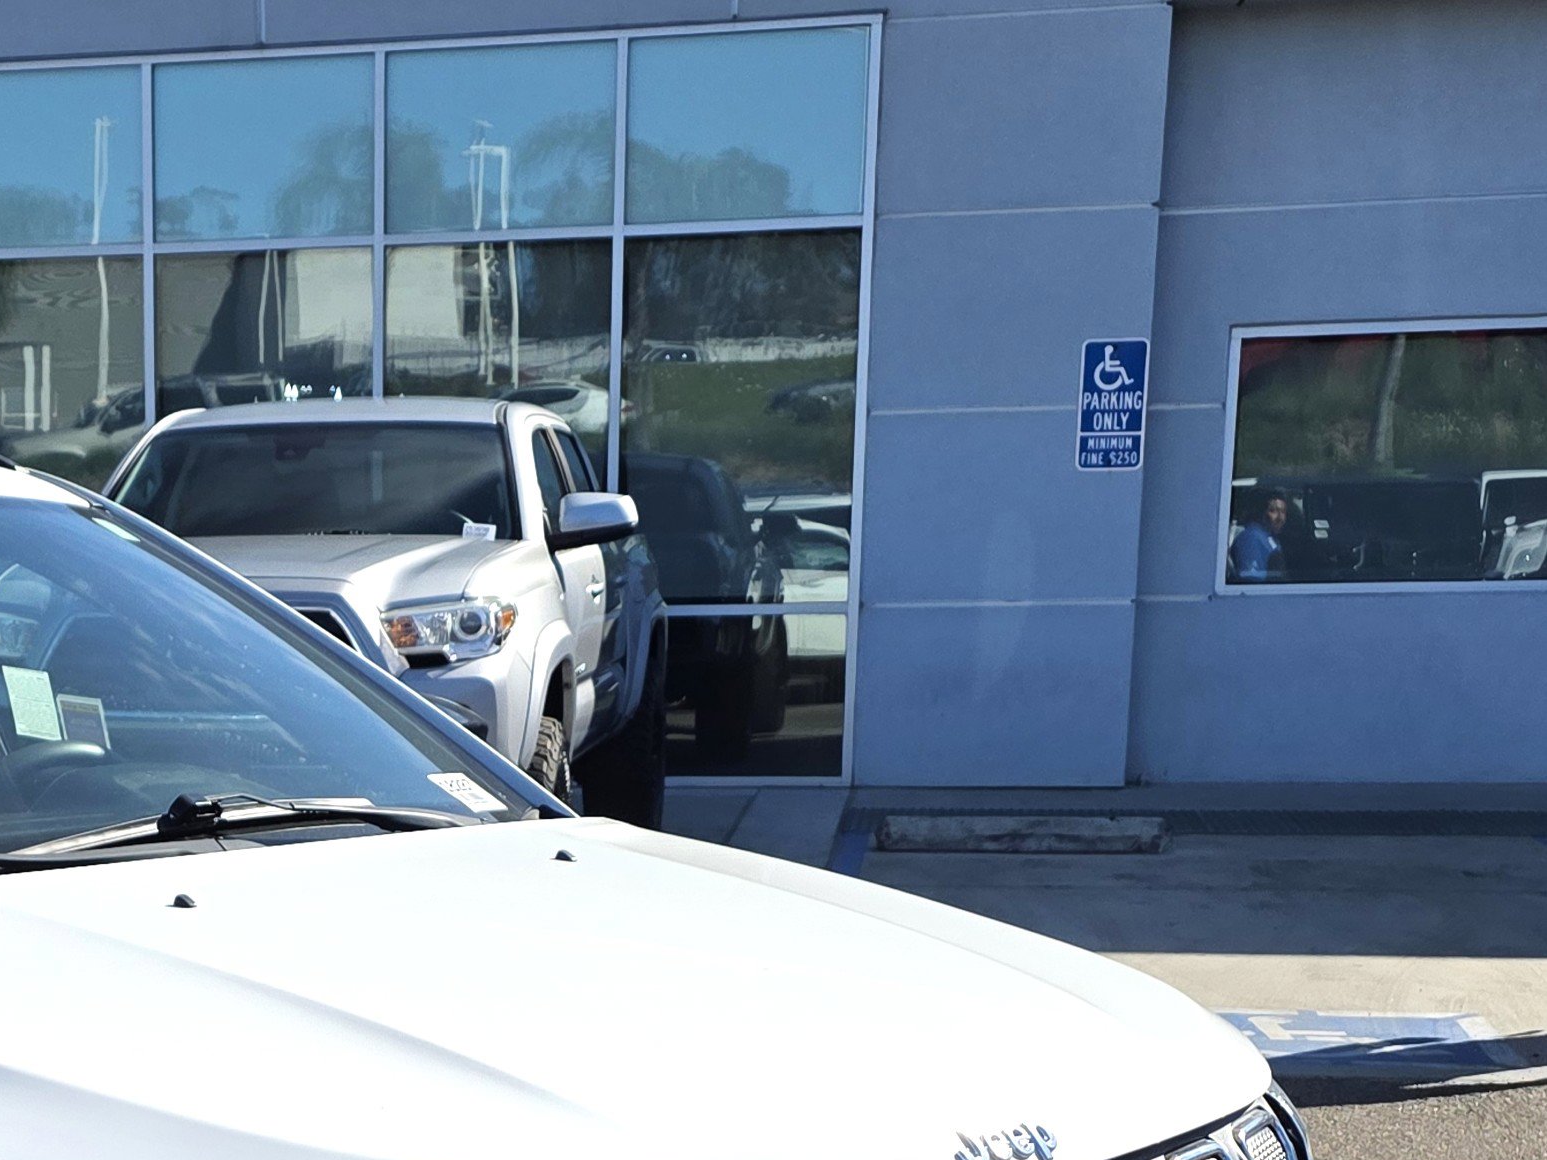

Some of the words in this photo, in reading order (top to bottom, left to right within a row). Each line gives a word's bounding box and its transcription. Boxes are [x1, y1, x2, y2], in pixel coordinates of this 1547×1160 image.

[1082, 391, 1143, 410] PARKING
[1093, 412, 1130, 430] ONLY
[1087, 437, 1132, 449] MINIMUM
[1081, 452, 1104, 465] FINE
[1109, 452, 1138, 465] $250
